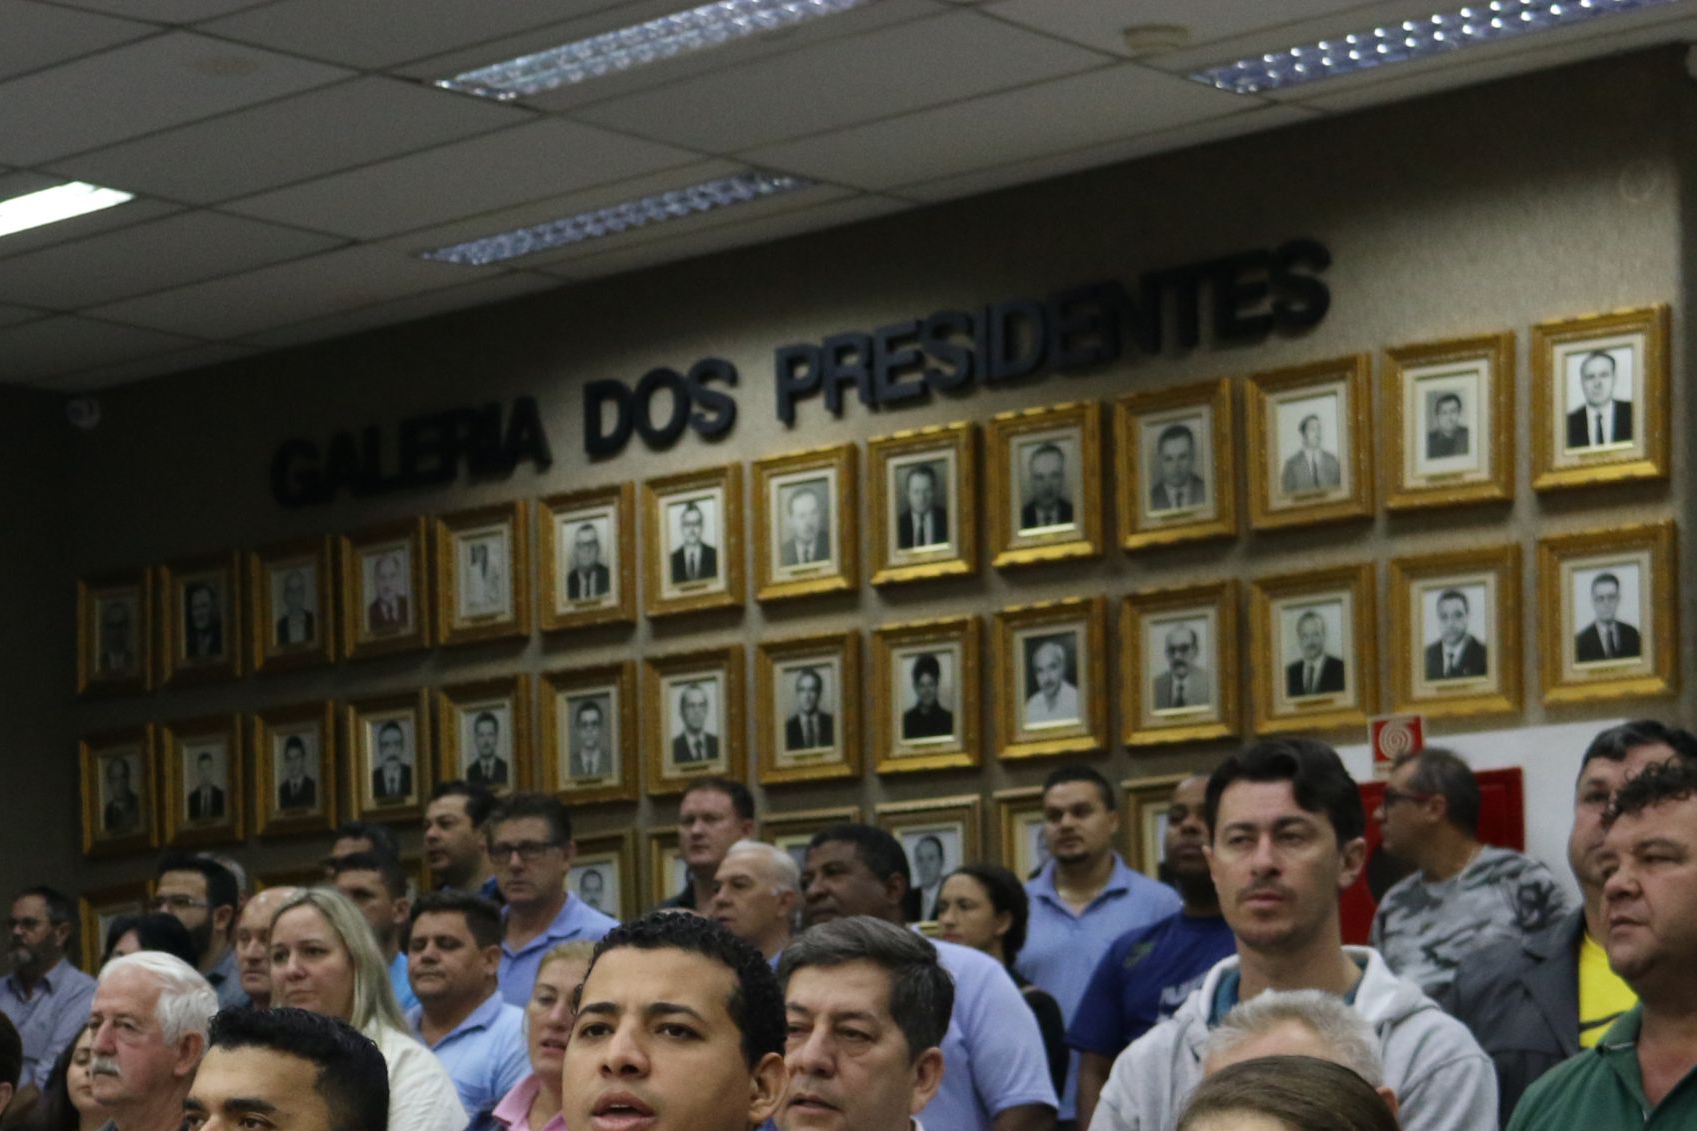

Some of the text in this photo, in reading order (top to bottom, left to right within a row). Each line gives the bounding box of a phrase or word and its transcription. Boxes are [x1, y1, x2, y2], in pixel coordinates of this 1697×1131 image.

[271, 237, 1332, 511] GALERIA DOS PRESIDENTES
